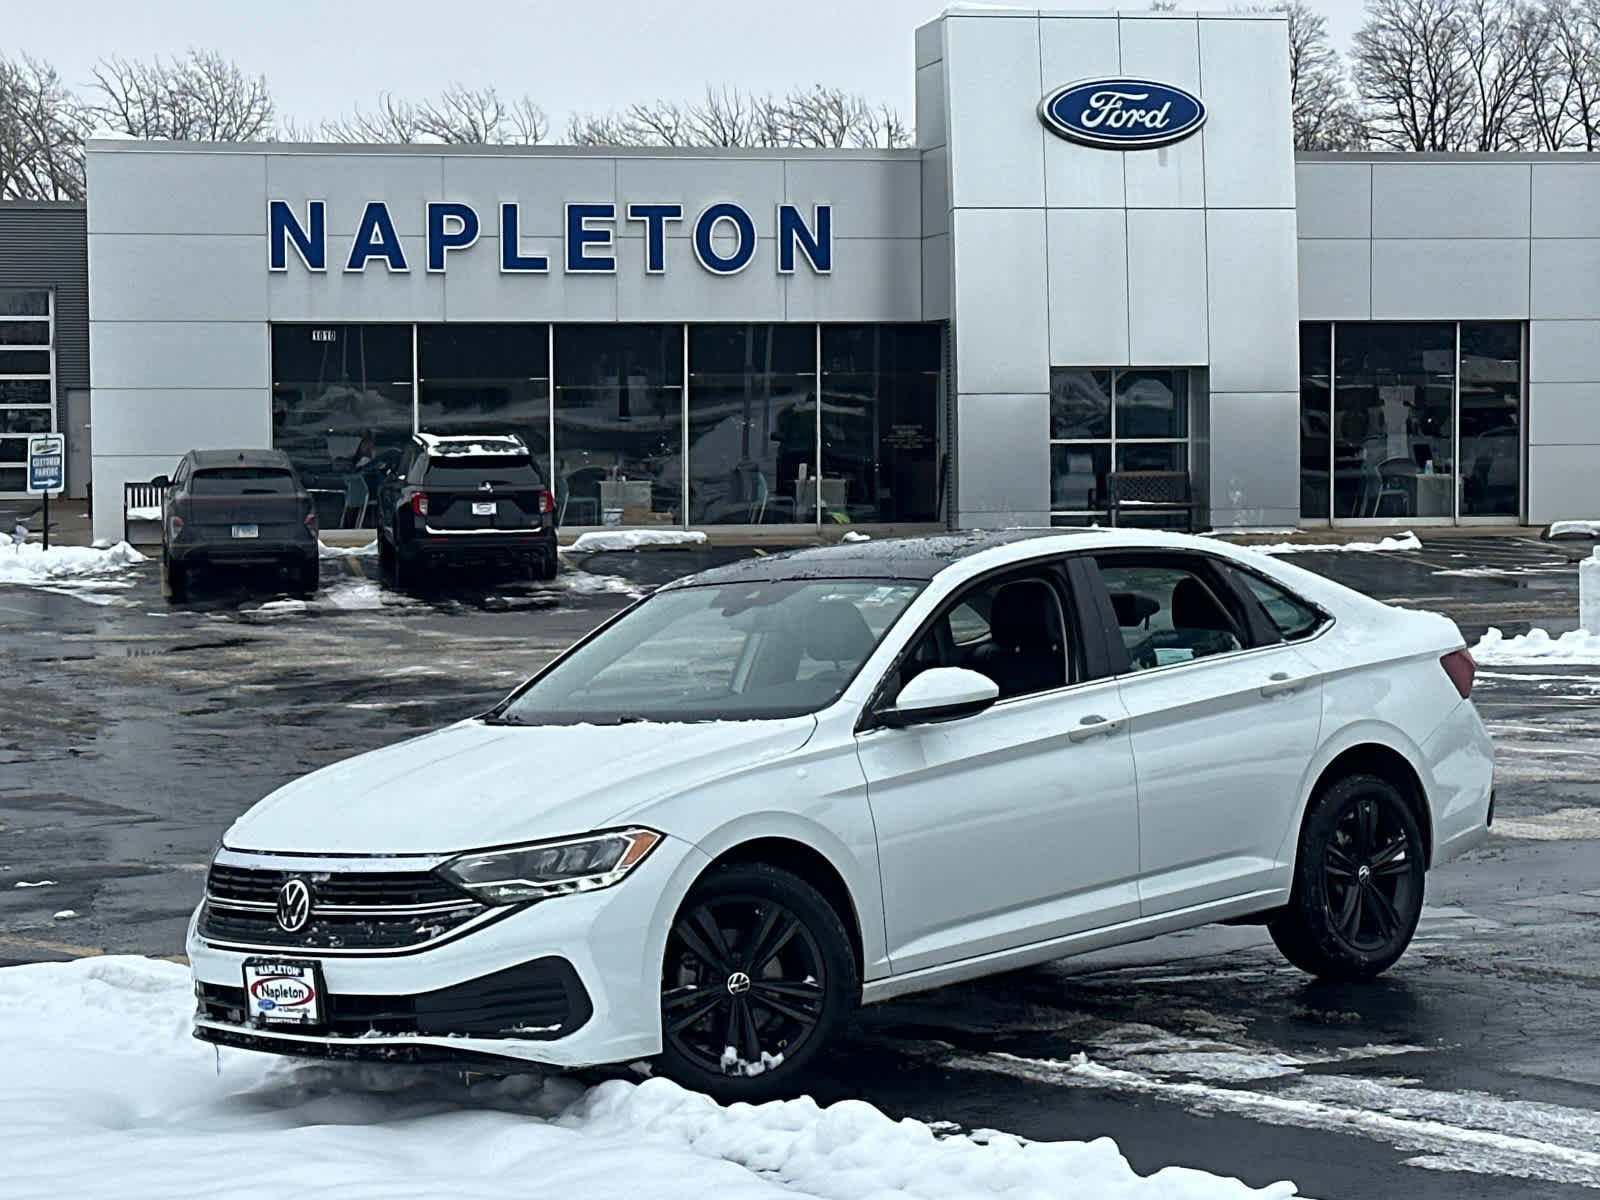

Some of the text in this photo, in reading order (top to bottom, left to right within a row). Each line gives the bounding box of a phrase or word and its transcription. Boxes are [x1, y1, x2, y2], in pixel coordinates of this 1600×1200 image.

[1080, 91, 1172, 128] Ford
[267, 200, 833, 275] NAPLETON
[260, 983, 305, 1001] Napleton
